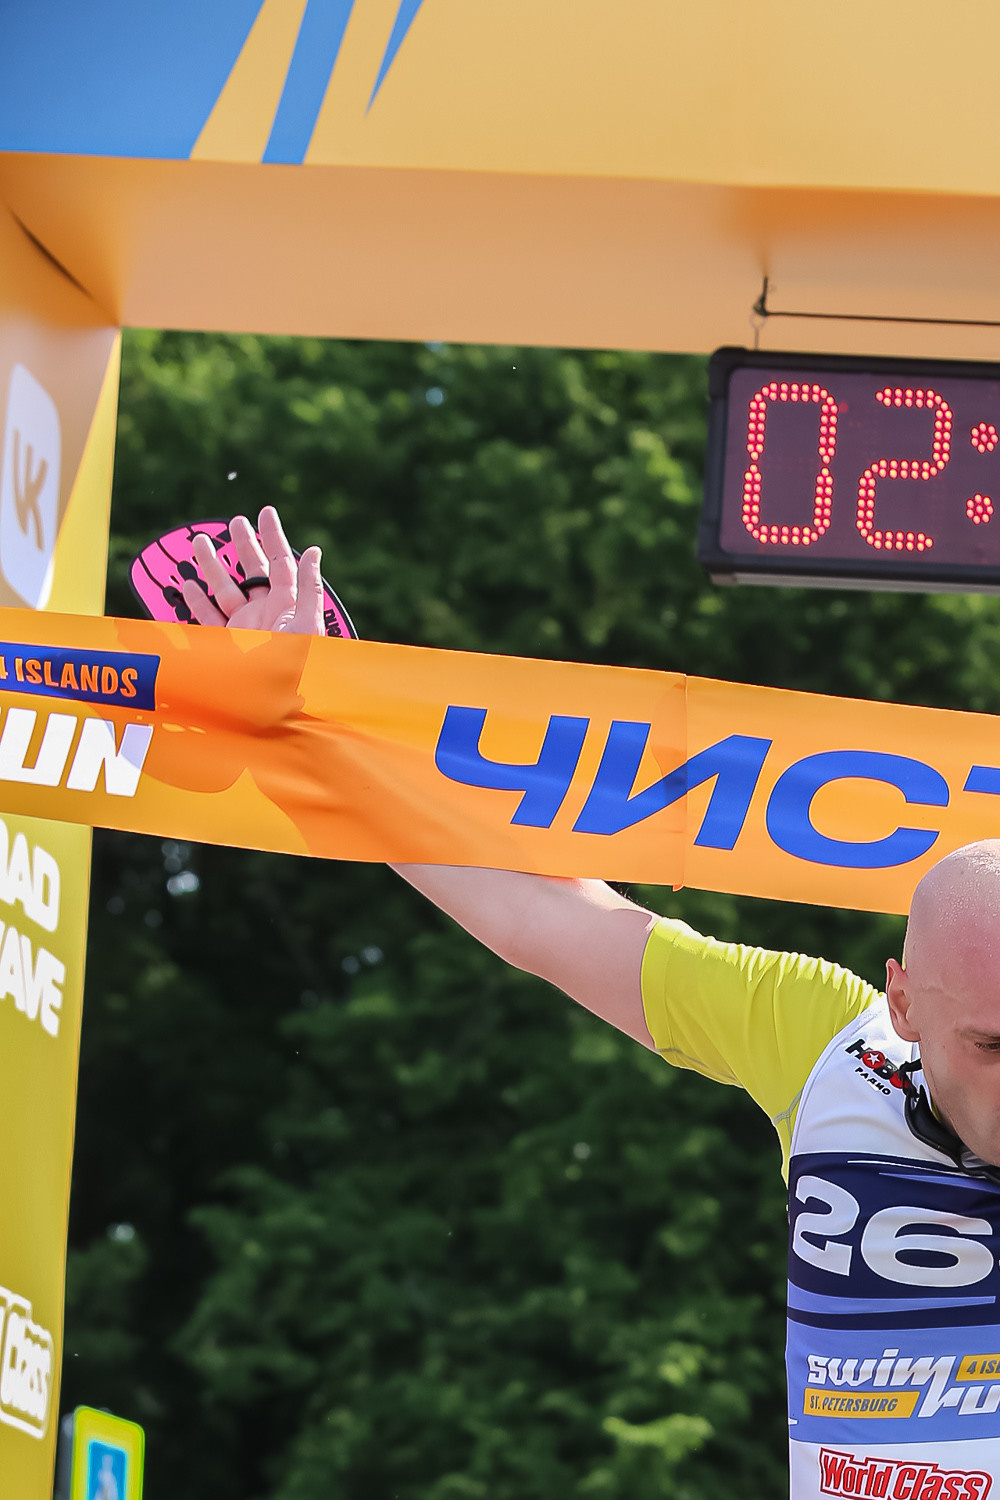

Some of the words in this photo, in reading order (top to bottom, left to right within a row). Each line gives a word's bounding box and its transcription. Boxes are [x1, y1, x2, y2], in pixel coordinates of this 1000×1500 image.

[15, 657, 138, 698] ISLANDS
[0, 706, 154, 797] UN
[855, 1067, 891, 1095] РАДИО
[967, 1360, 976, 1374] 4
[810, 1395, 820, 1410] ST.
[823, 1398, 898, 1412] PETERSBURG
[824, 1455, 892, 1498] World
